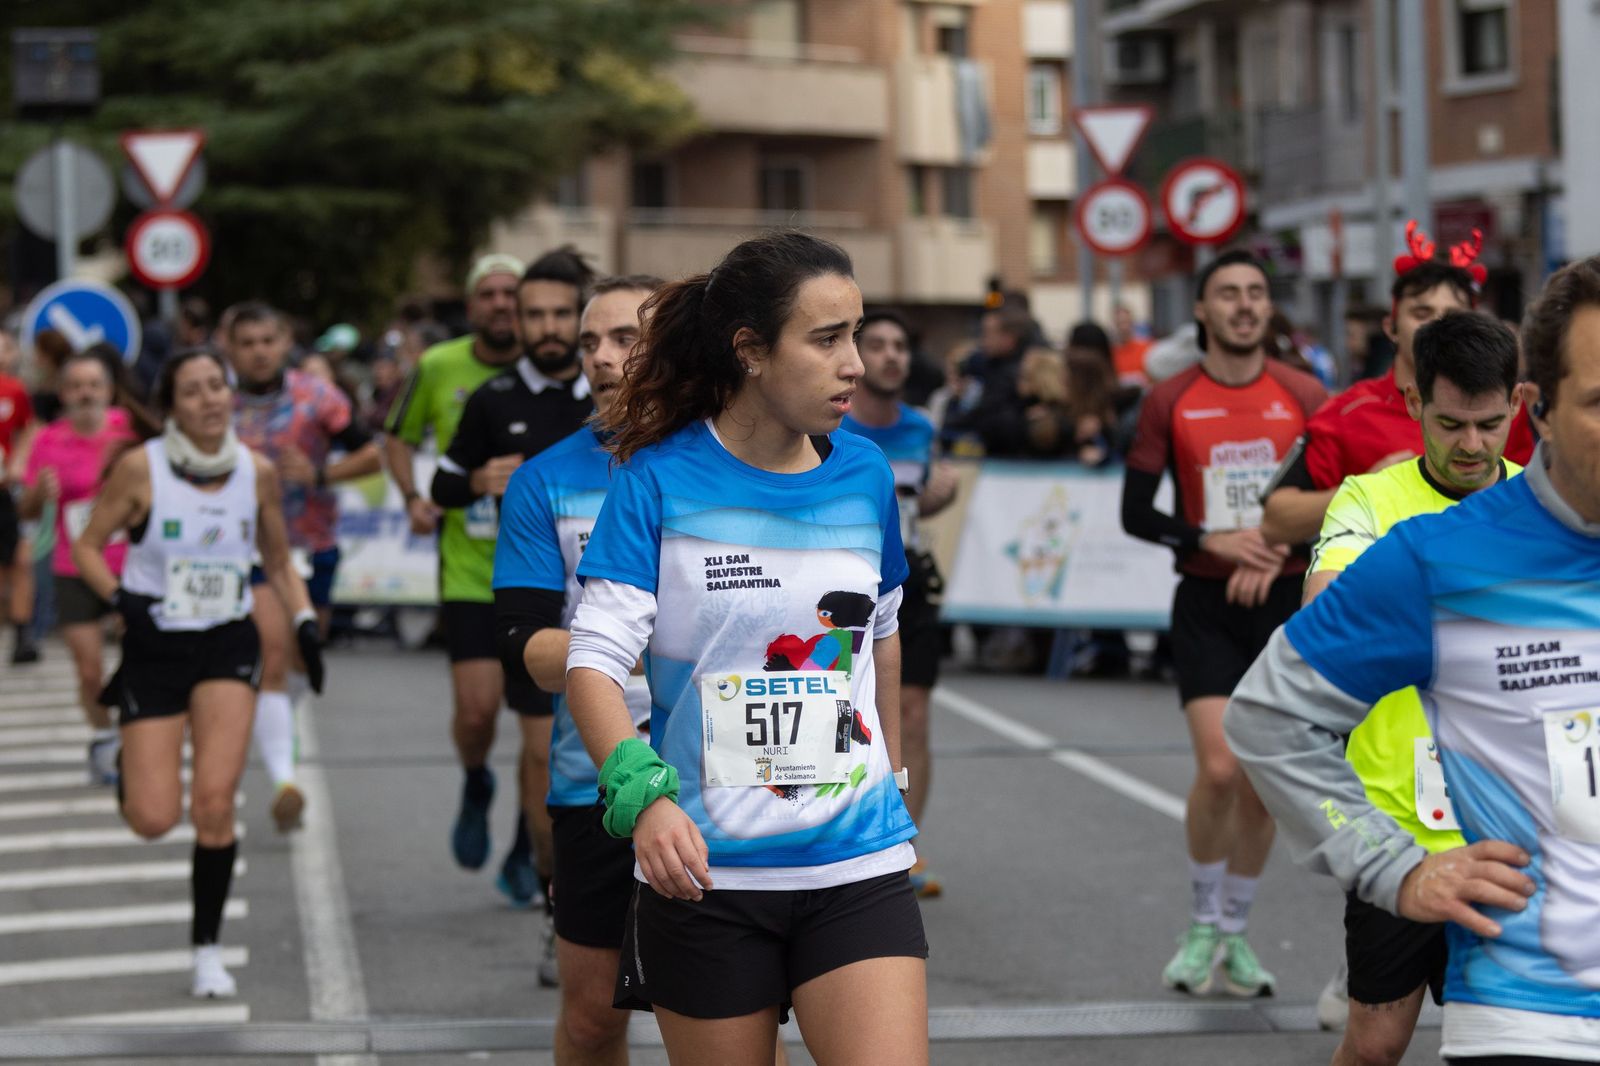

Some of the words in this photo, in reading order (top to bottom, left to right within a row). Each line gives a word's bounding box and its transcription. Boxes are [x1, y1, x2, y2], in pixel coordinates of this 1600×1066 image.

[704, 556, 723, 567] XLI
[725, 554, 750, 565] SAN
[705, 566, 763, 579] SILVESTRE
[706, 578, 782, 591] SALMANTINA
[1496, 646, 1521, 659] XLI
[1527, 641, 1561, 655] SAN
[1498, 656, 1581, 675] SILVESTRE
[745, 677, 837, 697] SETEL
[1499, 671, 1600, 692] SALMANTIN
[746, 701, 803, 746] 517
[763, 746, 789, 755] NURI
[774, 763, 816, 773] Ayuntamiento
[775, 773, 783, 781] de
[783, 772, 816, 781] Salamanca
